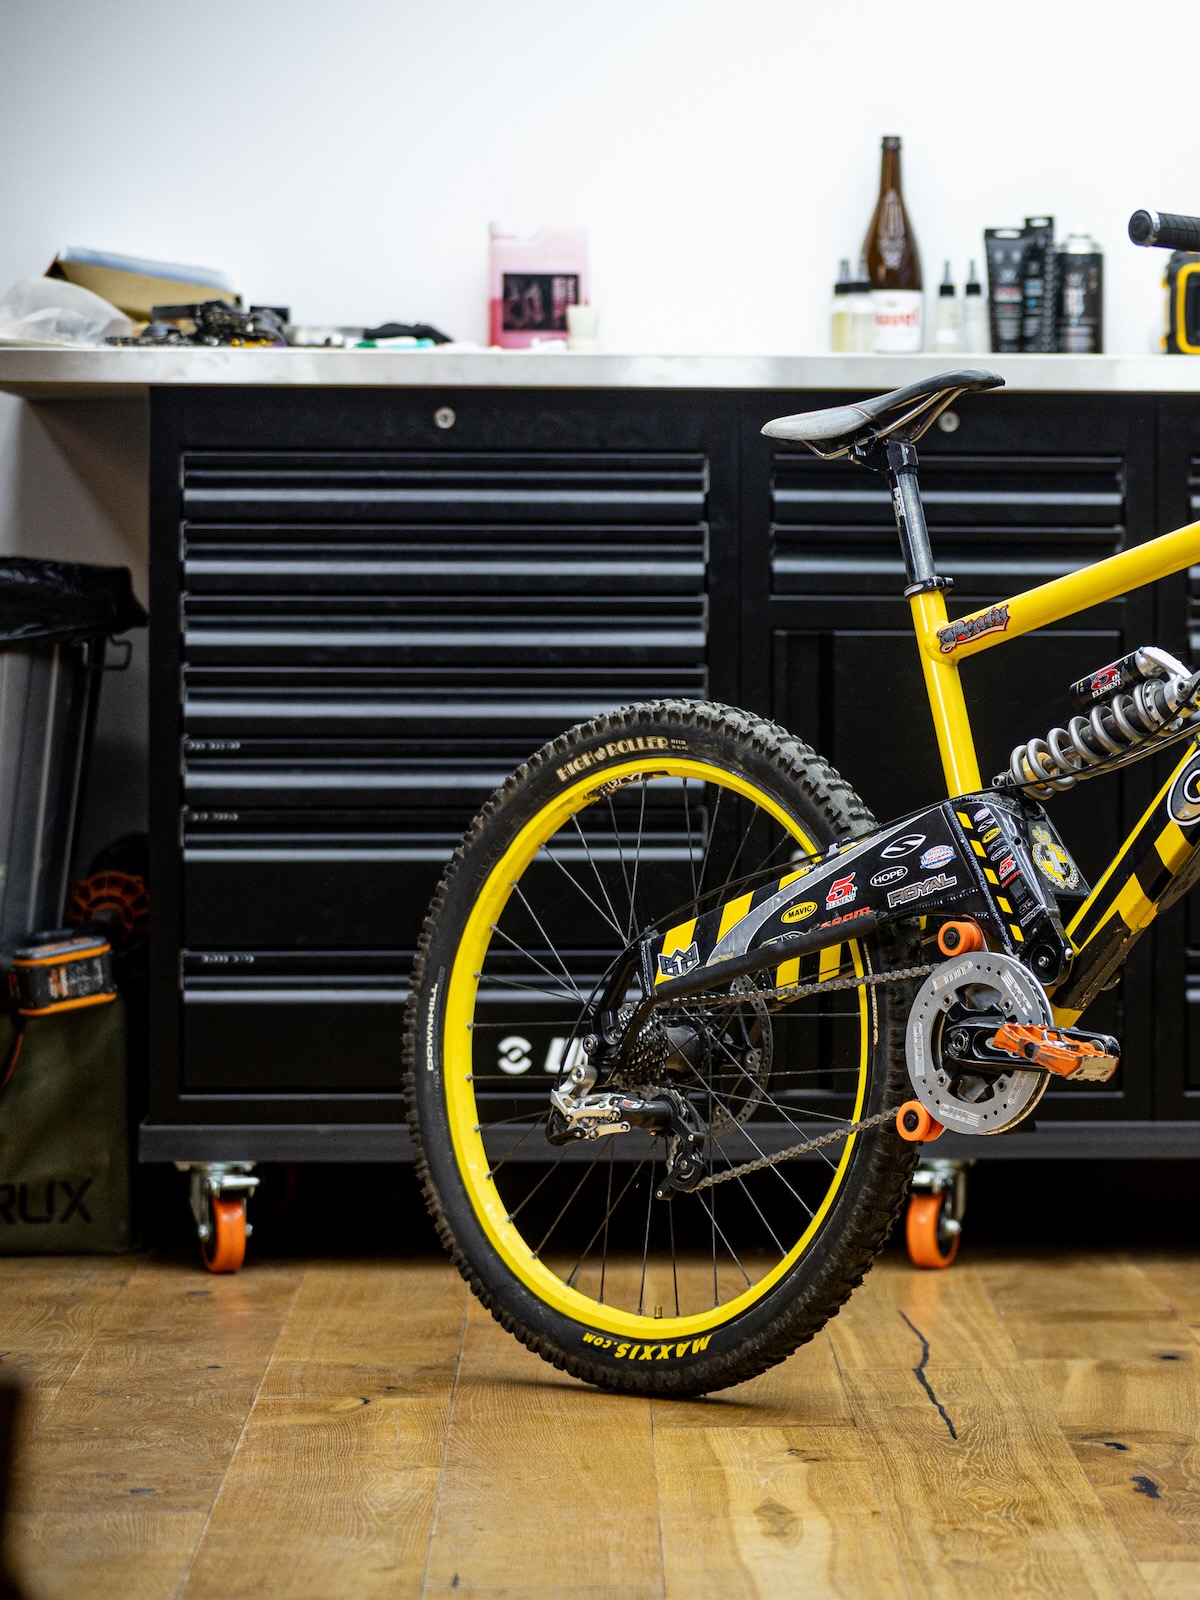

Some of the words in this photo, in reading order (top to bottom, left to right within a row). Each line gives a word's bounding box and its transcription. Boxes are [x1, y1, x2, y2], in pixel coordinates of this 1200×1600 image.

[1091, 679, 1122, 698] ELEMENT
[556, 750, 597, 782] HIGH
[605, 736, 669, 757] ROLLER
[873, 868, 904, 883] HOPE
[887, 873, 957, 908] ROYAL
[788, 905, 813, 919] MAVIC
[426, 983, 438, 1071] DOWNHILL
[582, 1332, 713, 1360] MAXXIS.COM
